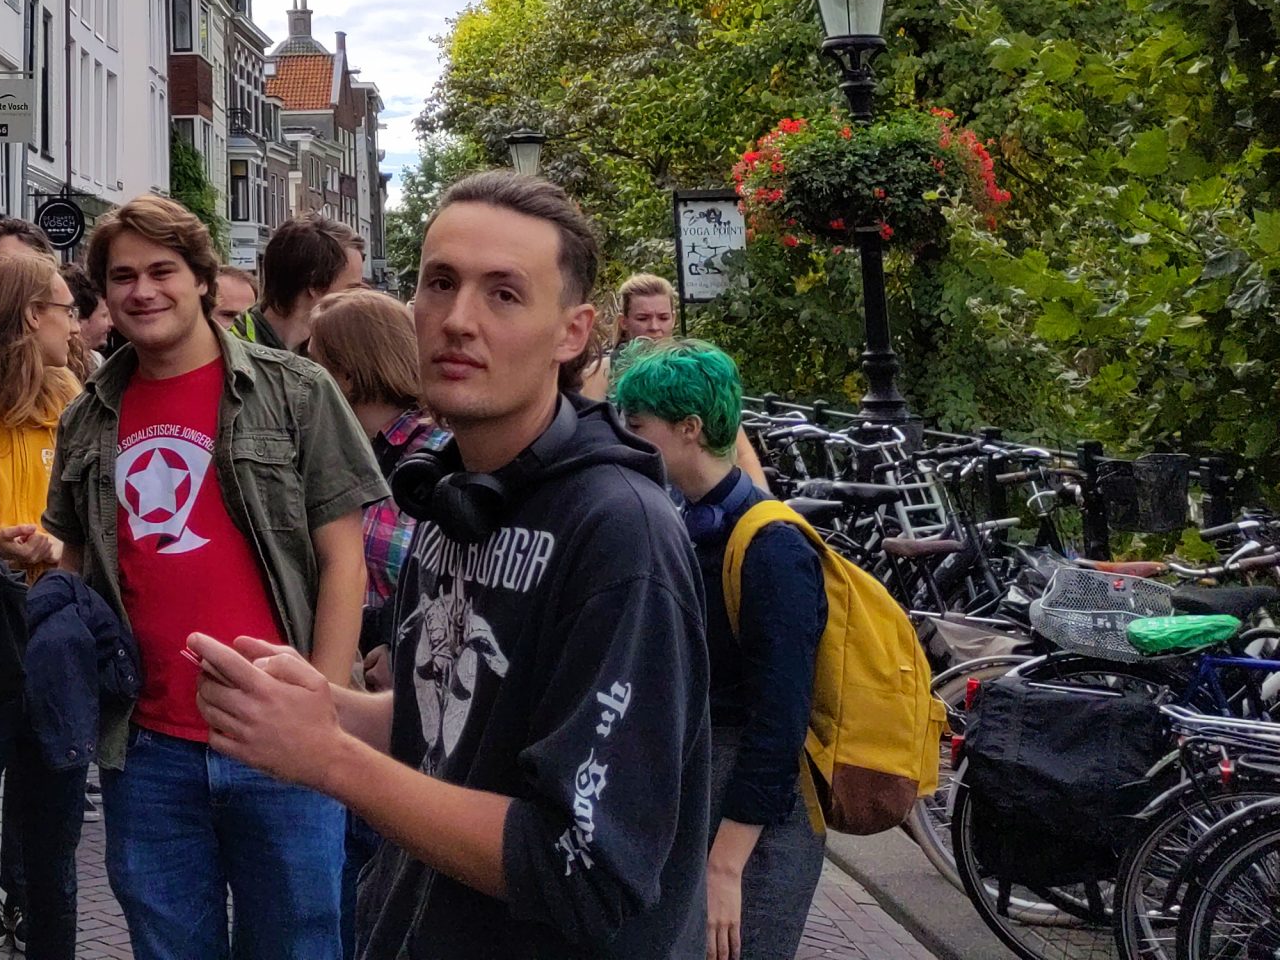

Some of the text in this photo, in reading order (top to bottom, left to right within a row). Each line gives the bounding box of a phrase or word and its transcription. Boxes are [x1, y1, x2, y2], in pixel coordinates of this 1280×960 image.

[7, 102, 29, 111] Vosch
[43, 220, 76, 228] VOSCH
[683, 226, 744, 236] YOGA POINT
[122, 424, 181, 449] SOCIALISTISCHE
[181, 427, 215, 452] JONGERE
